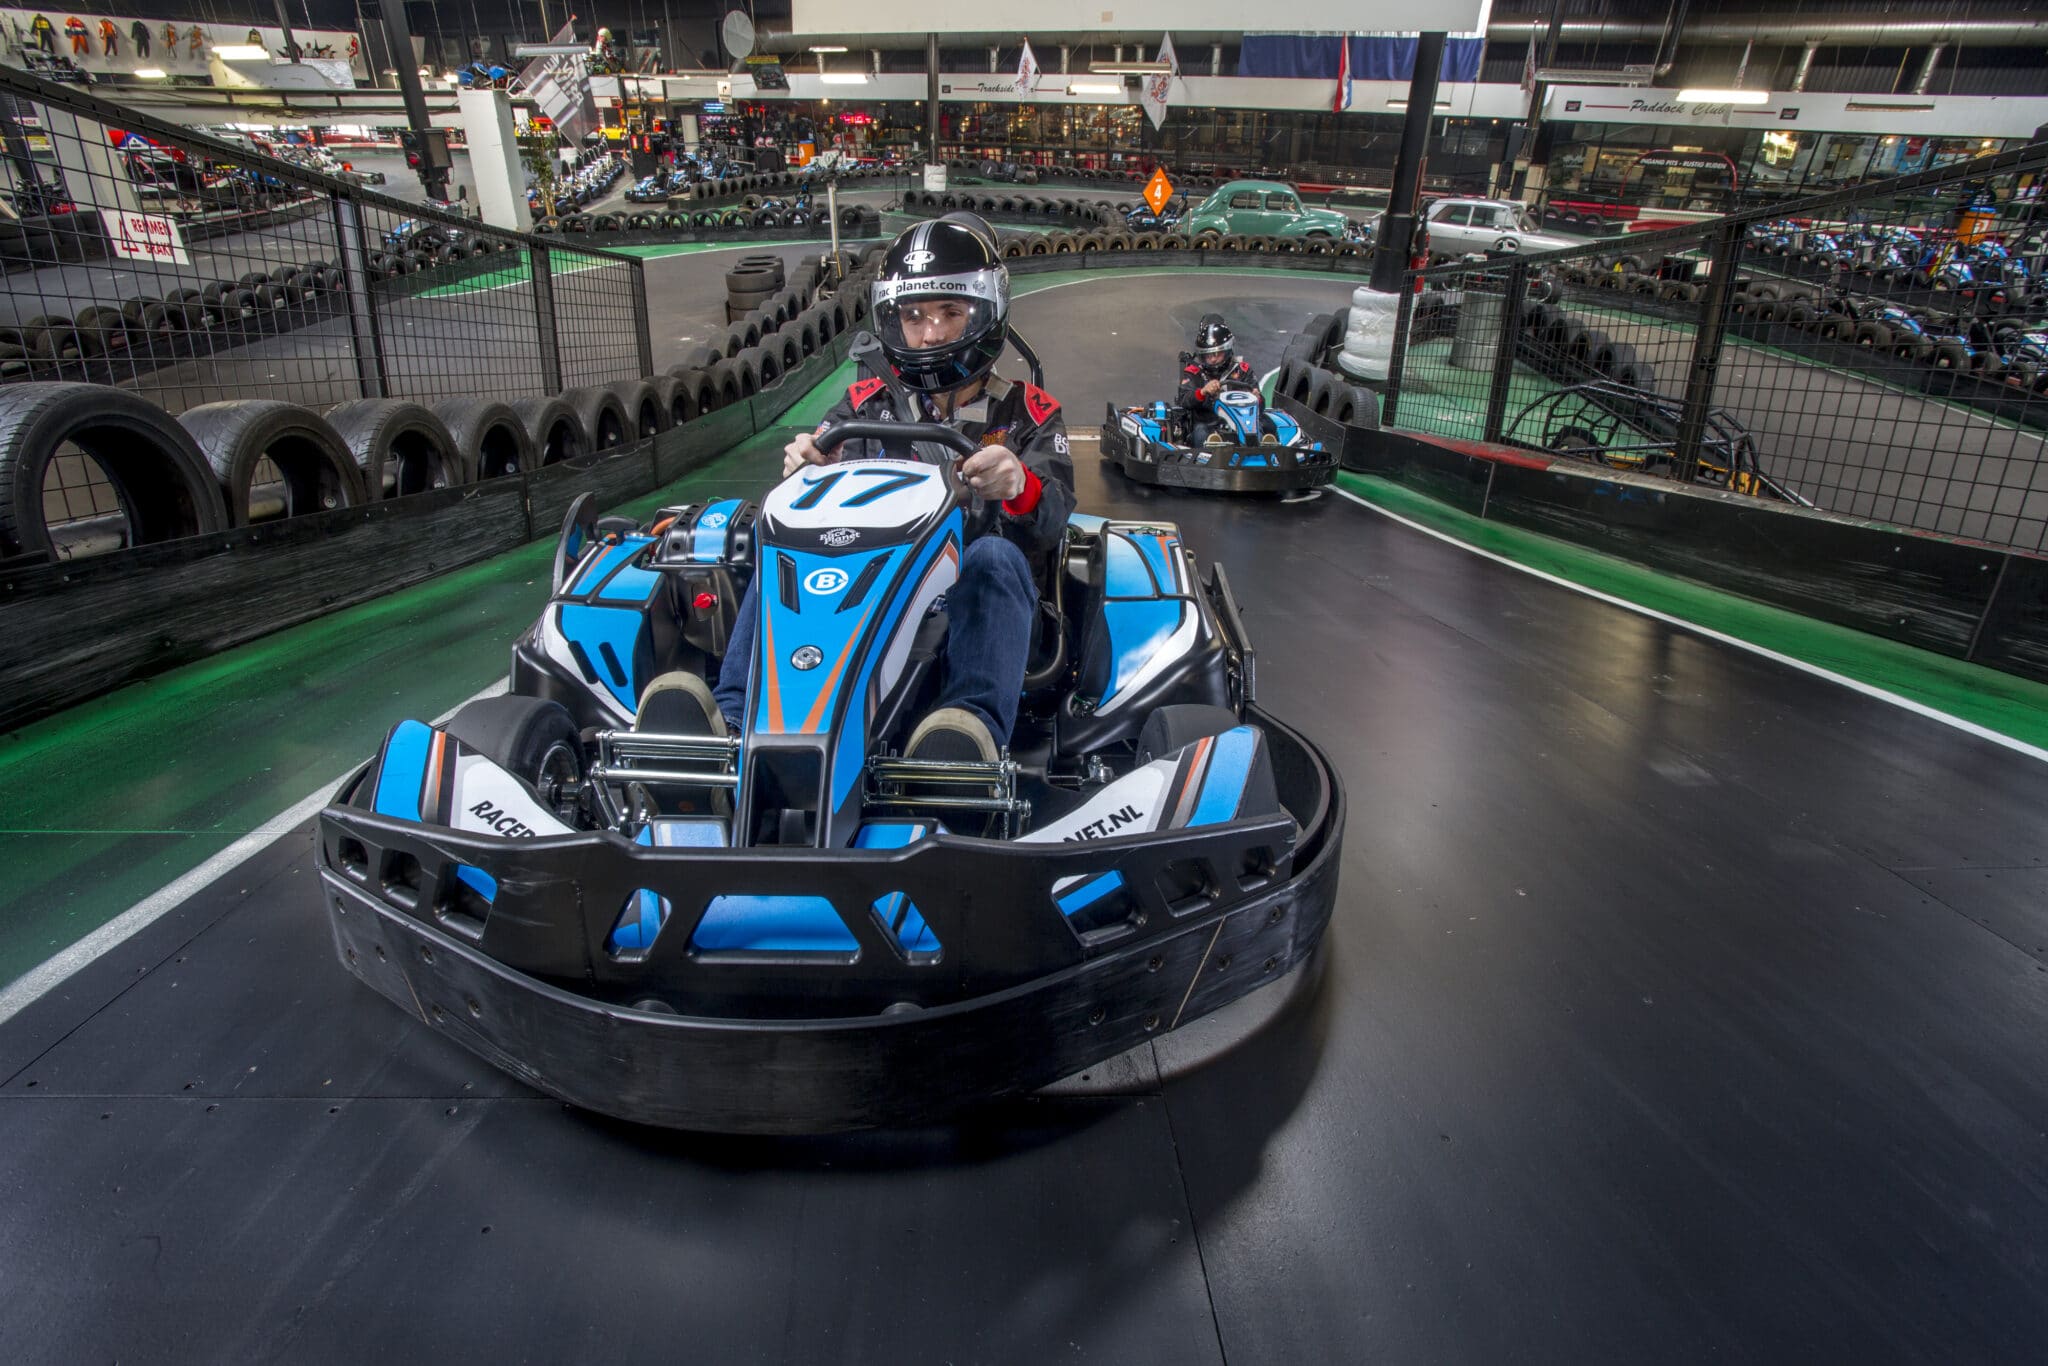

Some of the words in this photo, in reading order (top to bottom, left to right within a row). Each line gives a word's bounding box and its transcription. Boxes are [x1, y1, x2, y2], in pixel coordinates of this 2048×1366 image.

[977, 82, 1014, 93] Trackside
[1629, 99, 1685, 113] Paddock
[1692, 103, 1726, 115] Club
[1154, 184, 1162, 199] 4
[878, 280, 967, 298] racplanet.com
[789, 468, 931, 510] 17
